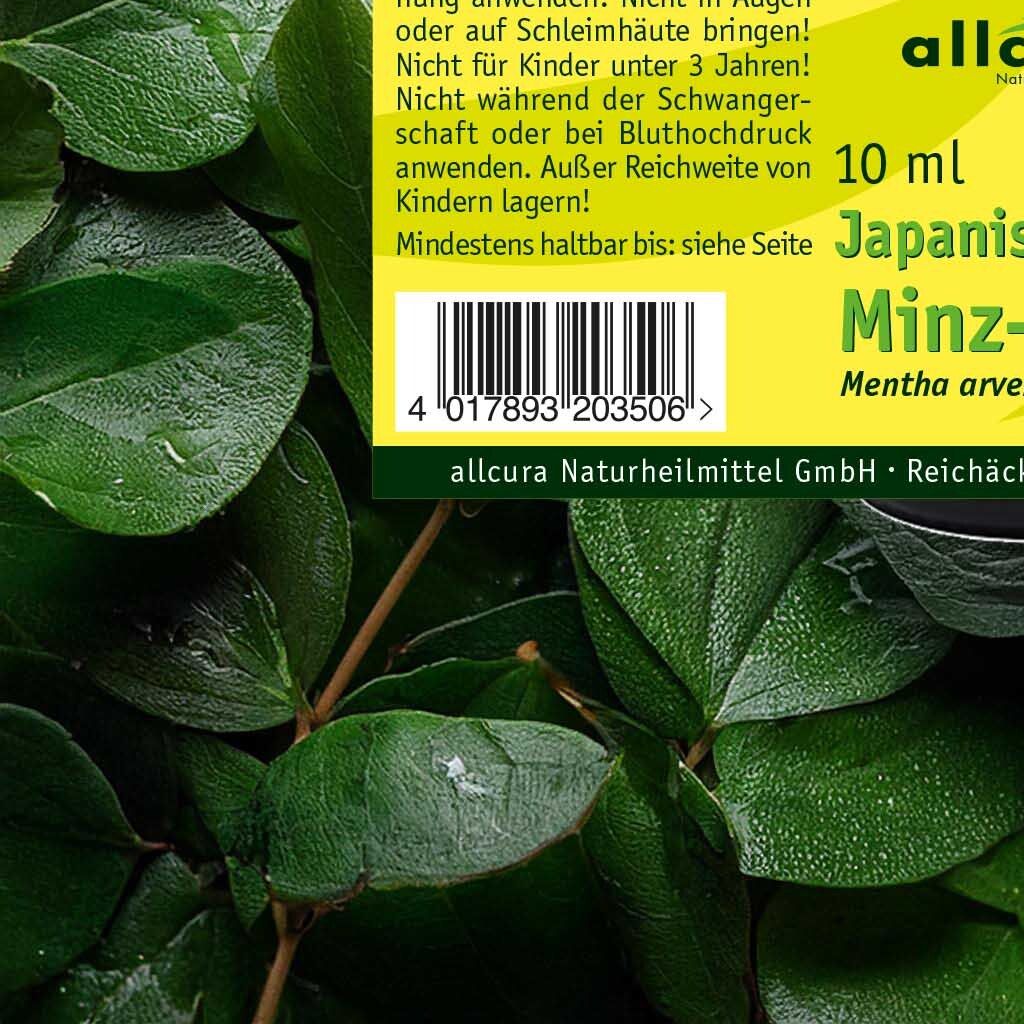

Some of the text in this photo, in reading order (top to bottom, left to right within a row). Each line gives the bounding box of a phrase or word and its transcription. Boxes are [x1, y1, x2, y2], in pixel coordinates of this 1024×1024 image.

[396, 17, 809, 48] oder auf Schleimhäute bringen!
[398, 52, 808, 76] Nicht für Kinder unter 3 Jahren!
[398, 86, 811, 116] Nicht während der Schwanger-
[396, 120, 811, 144] schaft oder bei Bluthochdruck
[396, 154, 810, 178] anwenden. Außer Reichweite von
[836, 139, 964, 184] 10 ml
[398, 188, 589, 219] Kindern lagern!
[397, 231, 812, 255] Mindestens haltbar bis: siehe Seite
[841, 370, 949, 396] Mentha
[407, 395, 427, 422] 4
[446, 395, 558, 422] 017893
[573, 395, 686, 422] 203506
[451, 458, 546, 482] allcura
[563, 458, 783, 482] Naturheilmittel
[796, 458, 874, 482] GmbH
